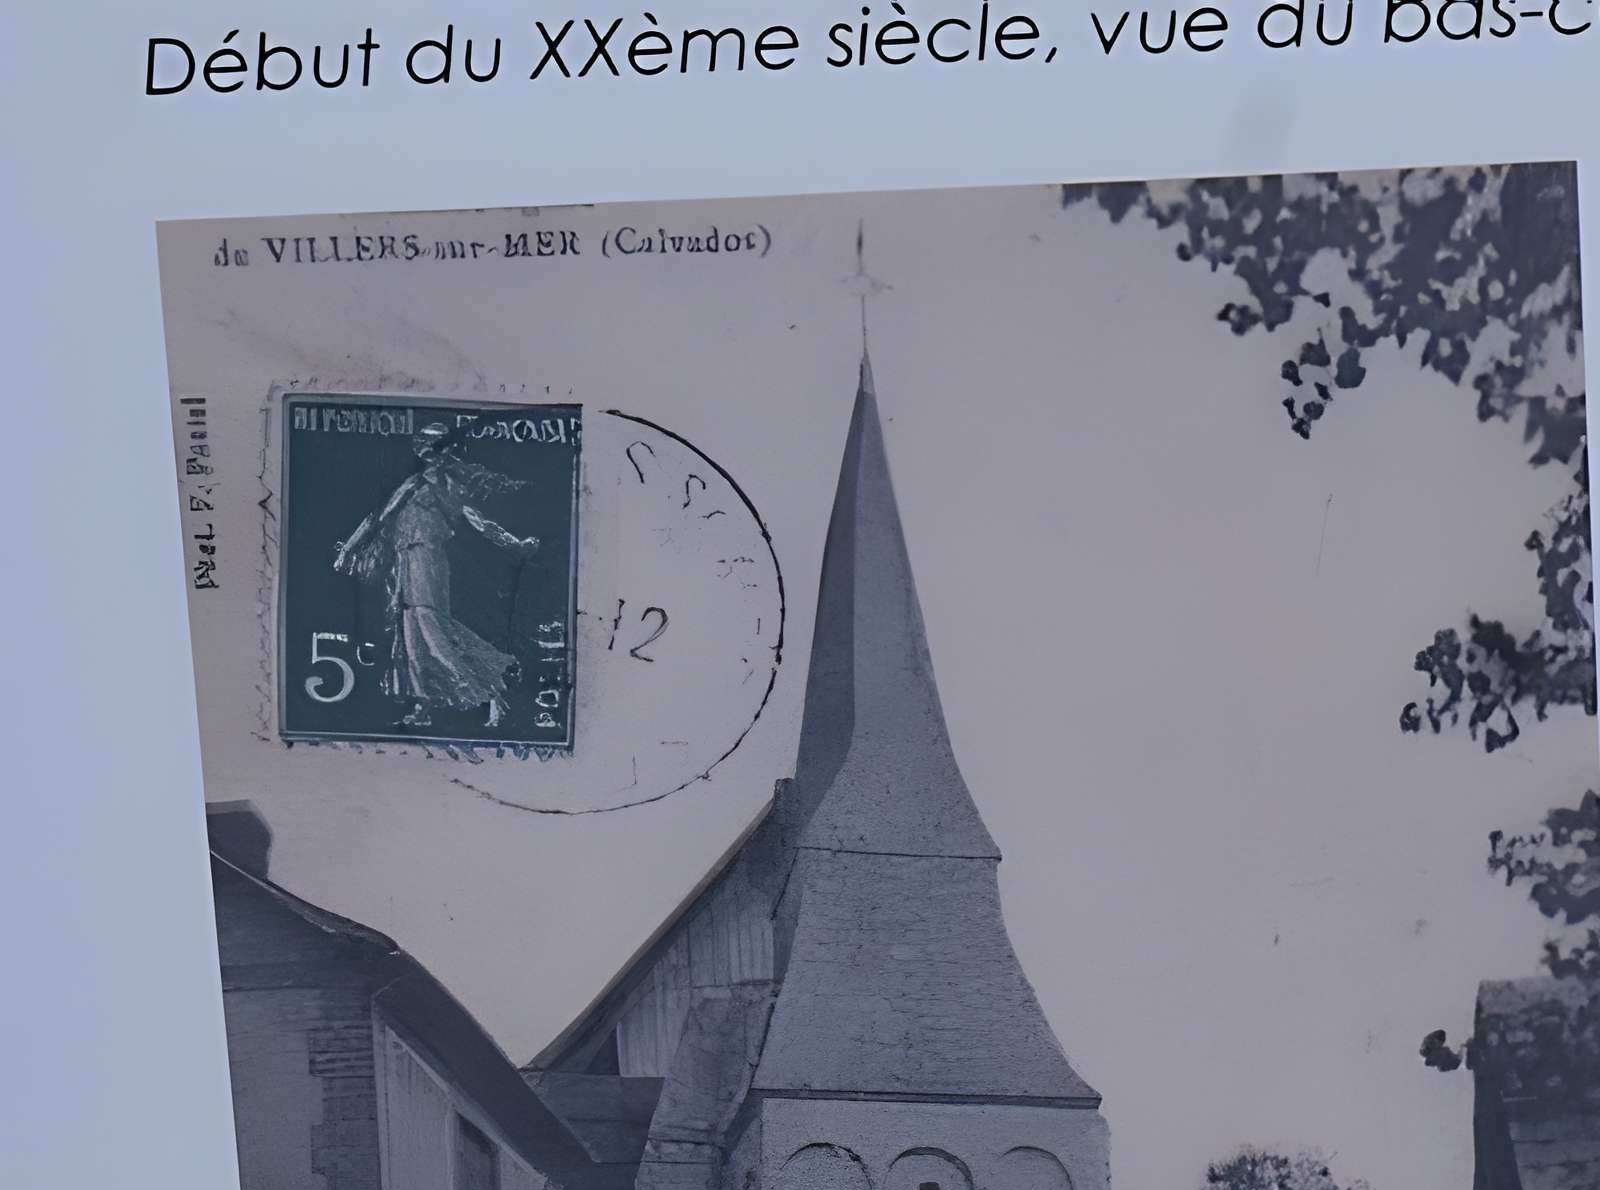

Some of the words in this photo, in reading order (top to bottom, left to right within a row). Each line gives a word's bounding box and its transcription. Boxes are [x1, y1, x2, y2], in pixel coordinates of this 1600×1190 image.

[146, 28, 380, 95] Début
[406, 24, 501, 84] du
[530, 12, 799, 79] XXème
[827, 2, 1057, 67] siècle,
[1091, 8, 1228, 54] vue
[1258, 0, 1353, 48] du
